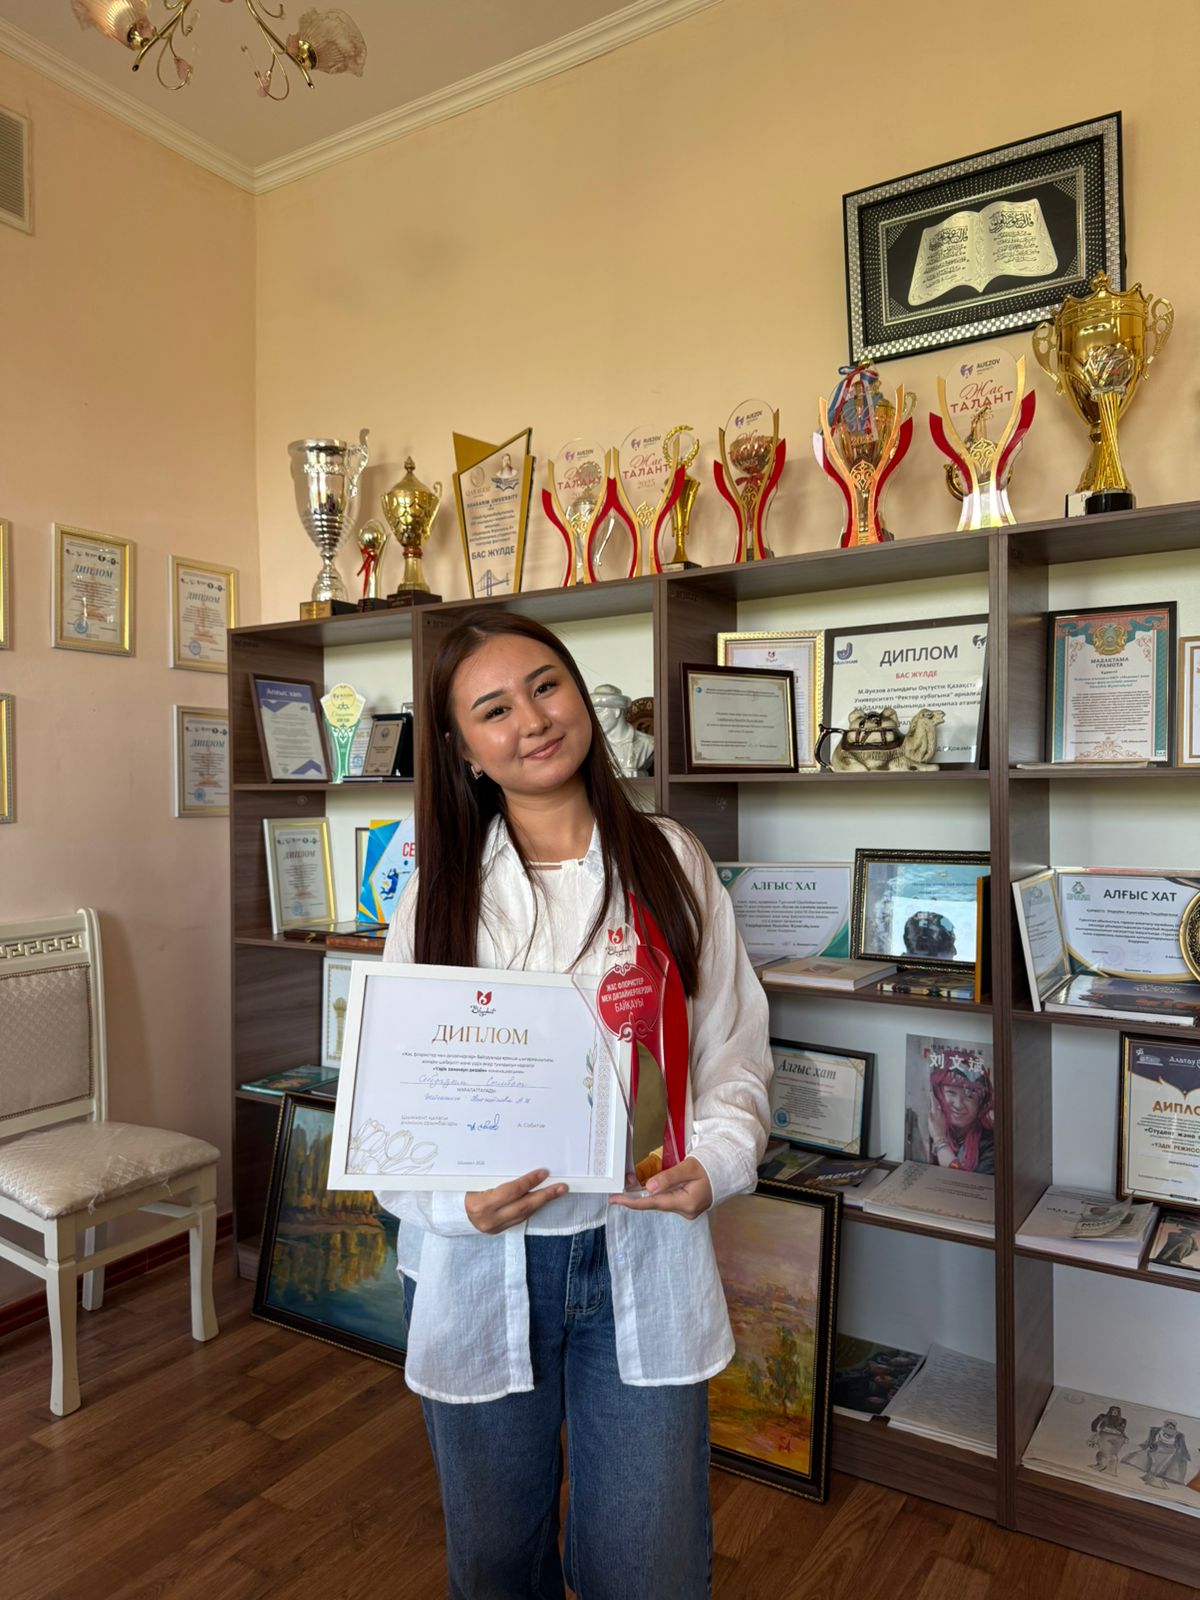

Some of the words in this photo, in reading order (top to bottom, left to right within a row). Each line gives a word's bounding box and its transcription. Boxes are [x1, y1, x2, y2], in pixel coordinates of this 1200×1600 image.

[976, 358, 1001, 369] AUEZOV
[950, 390, 1014, 414] ТАЛАНТ
[622, 464, 669, 480] ТАЛАНТ
[471, 550, 487, 561] БАС
[880, 644, 958, 668] ДИПЛОМ
[895, 671, 910, 680] БАС
[751, 881, 793, 891] АЛҒЫС
[795, 881, 817, 891] ХАТ
[1104, 889, 1149, 901] АЛҒЫС
[1151, 891, 1178, 902] ХАТ
[606, 982, 618, 992] ЖАС
[601, 993, 612, 1003] МЕН
[431, 1024, 529, 1046] ДИПЛОМ
[812, 1066, 838, 1081] хат
